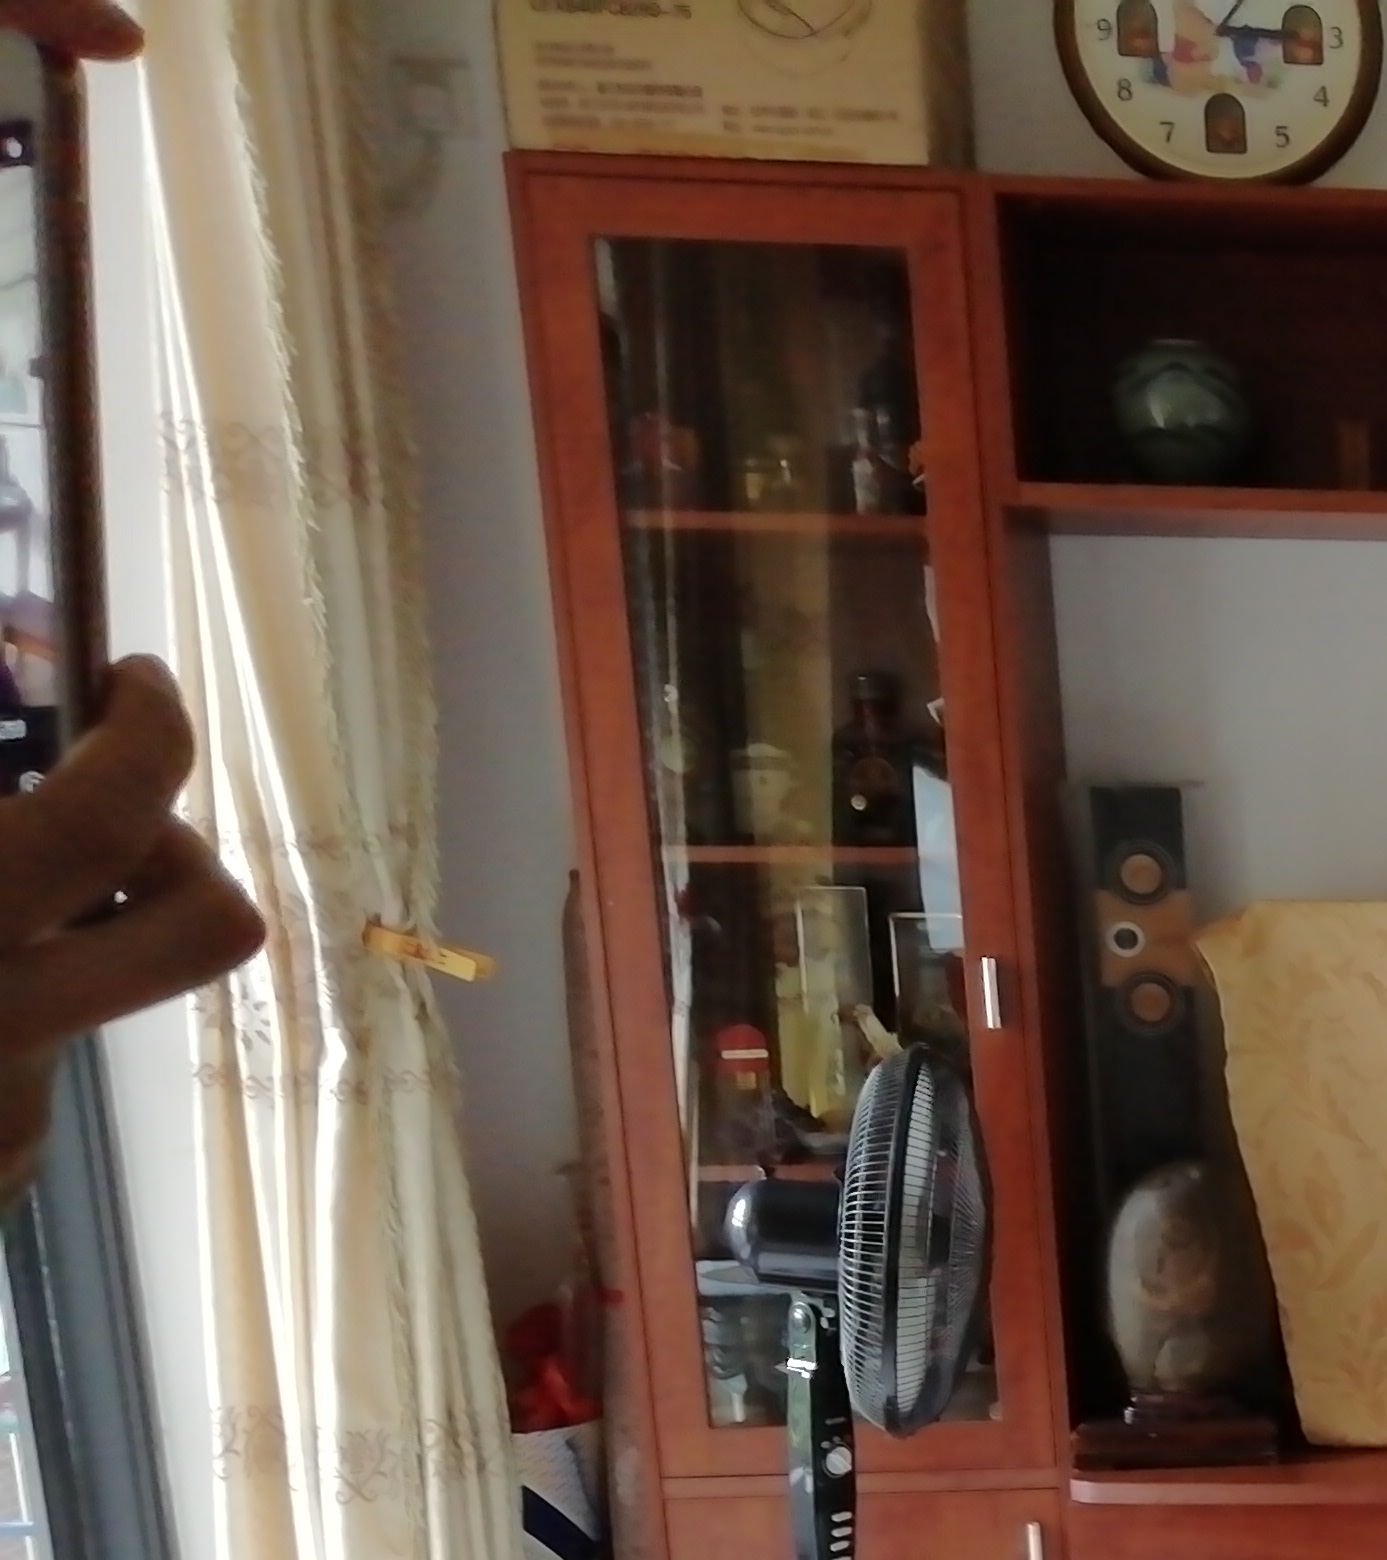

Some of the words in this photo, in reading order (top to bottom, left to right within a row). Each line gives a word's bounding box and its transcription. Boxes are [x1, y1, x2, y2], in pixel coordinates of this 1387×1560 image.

[1096, 18, 1112, 41] 9
[1328, 26, 1344, 49] 3
[1116, 78, 1133, 102] 8
[1313, 85, 1330, 108] 4
[1159, 121, 1175, 143] 7
[1274, 125, 1290, 148] 5
